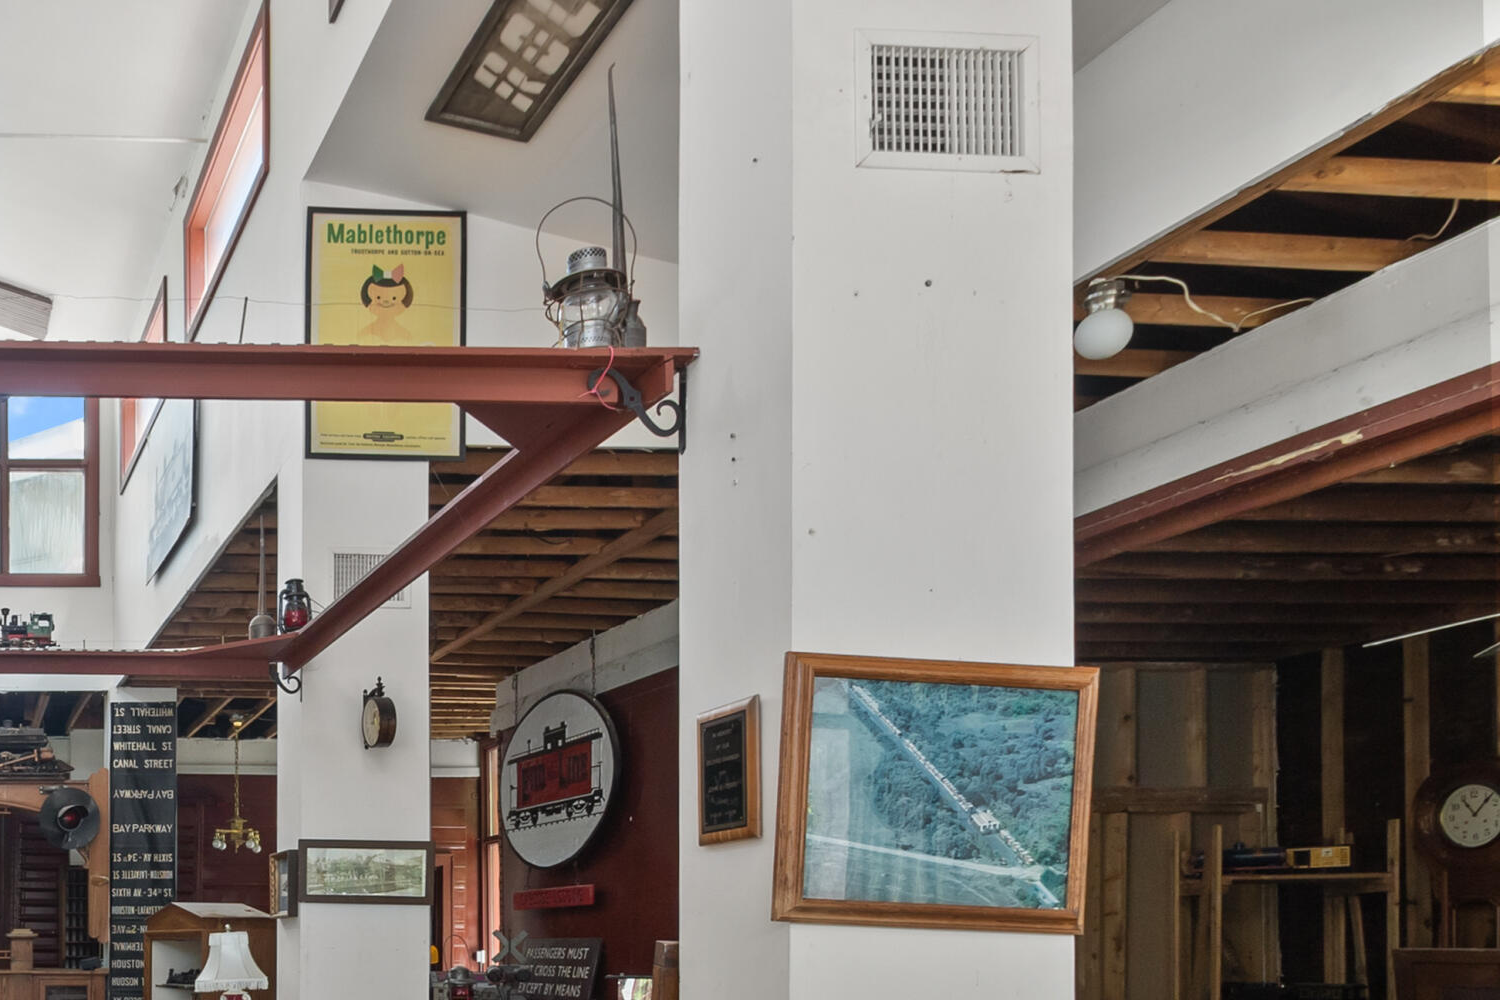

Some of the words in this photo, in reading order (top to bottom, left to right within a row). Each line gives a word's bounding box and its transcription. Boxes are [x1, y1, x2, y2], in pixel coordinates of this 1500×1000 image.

[327, 222, 446, 249] Mablethorpe
[130, 707, 173, 717] WHITEHALL
[113, 725, 141, 734] STREET
[147, 725, 172, 734] CANAL
[113, 741, 156, 751] WHITEHALL
[113, 759, 138, 769] CANAL
[144, 759, 173, 769] STREET
[113, 790, 154, 799] PARKWAY
[155, 790, 174, 799] BAY
[112, 823, 130, 833] BAY
[132, 823, 173, 833] PARKWAY
[111, 888, 131, 897] SIXTH
[526, 946, 565, 960] PASSENGERS
[566, 947, 590, 960] MUST
[534, 965, 556, 977] CROSS
[557, 965, 571, 978] THE
[572, 966, 590, 979] LINE
[111, 977, 138, 986] HUDSON
[517, 981, 542, 994] EXCEPT
[543, 982, 555, 995] BY
[555, 983, 581, 997] MEANS
